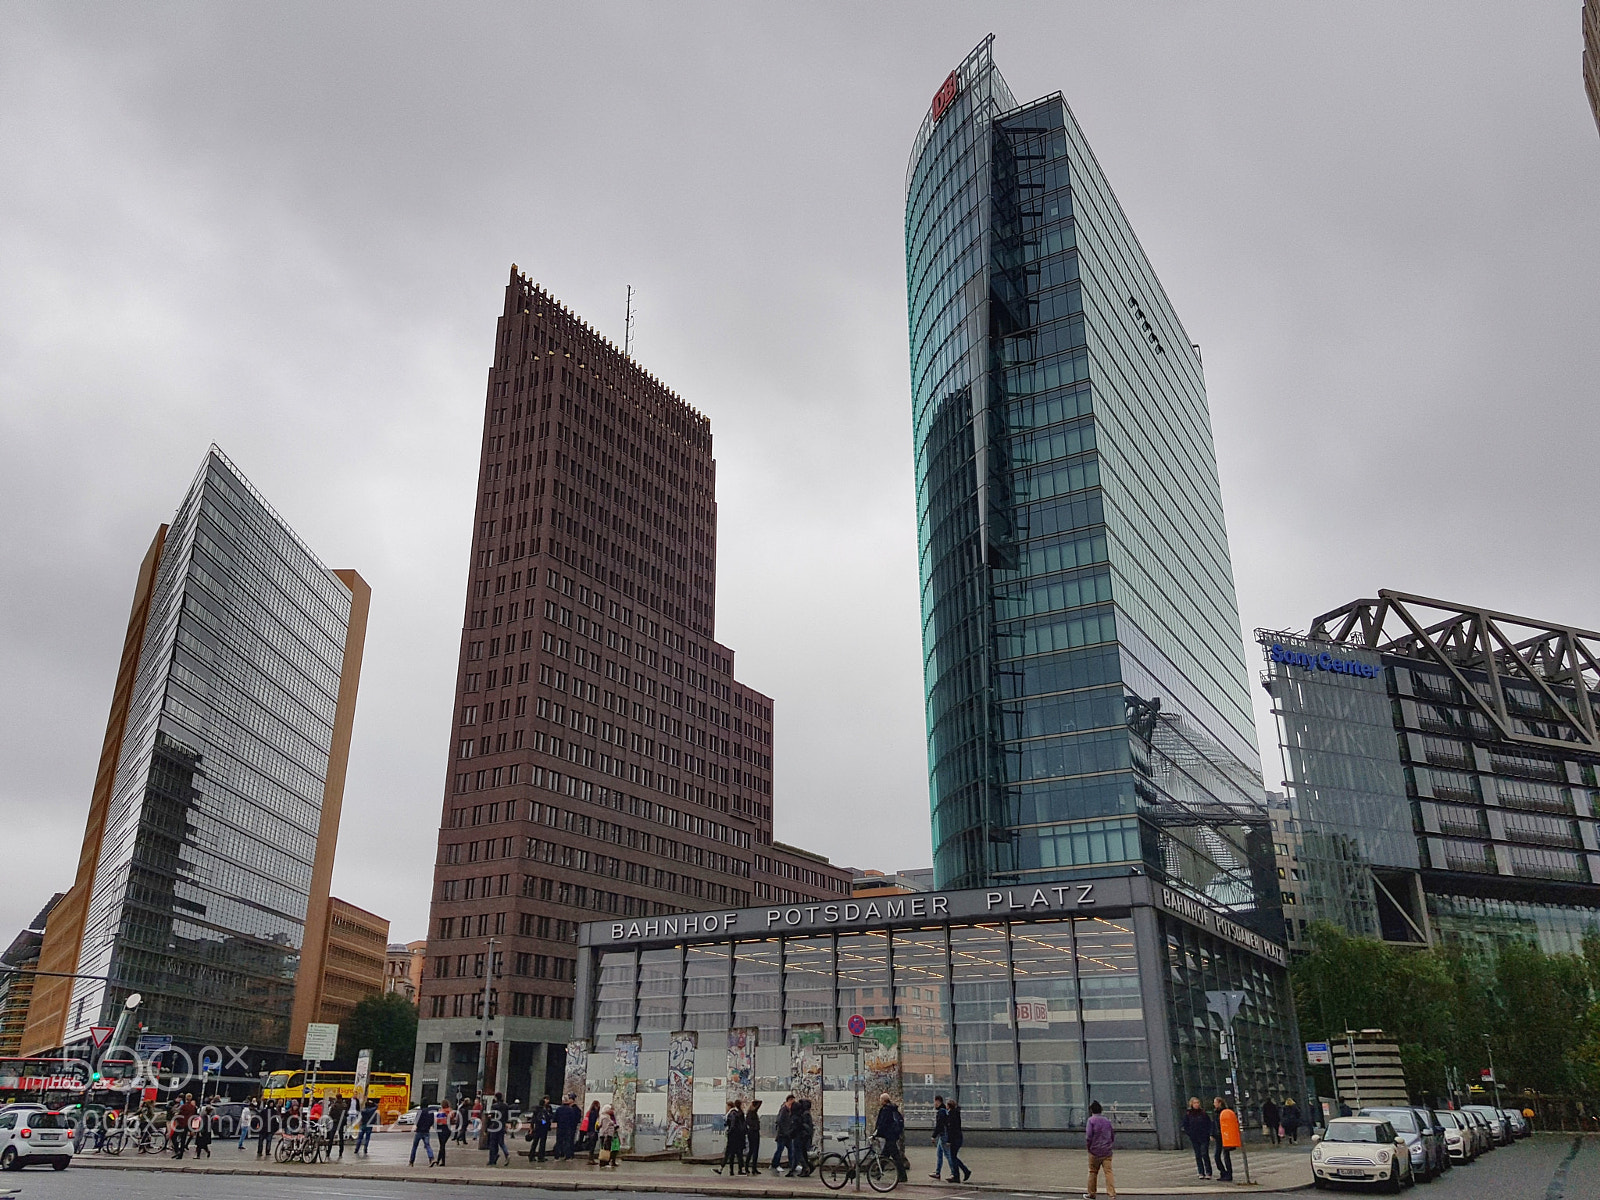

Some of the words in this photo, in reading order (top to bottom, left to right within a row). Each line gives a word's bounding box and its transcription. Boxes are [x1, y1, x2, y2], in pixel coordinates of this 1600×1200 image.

[933, 73, 955, 119] DB
[1271, 643, 1317, 671] Sony
[1317, 651, 1380, 679] Center
[611, 912, 738, 940] BAHNHOF
[766, 895, 949, 928] POTSDAMER
[986, 884, 1095, 911] PLATZ
[1162, 888, 1209, 926] BAHNHOF
[1214, 915, 1259, 951] POTSDAMER
[1262, 940, 1283, 962] PLATZ
[1035, 1006, 1046, 1020] DB
[49, 1073, 110, 1089] Höffer
